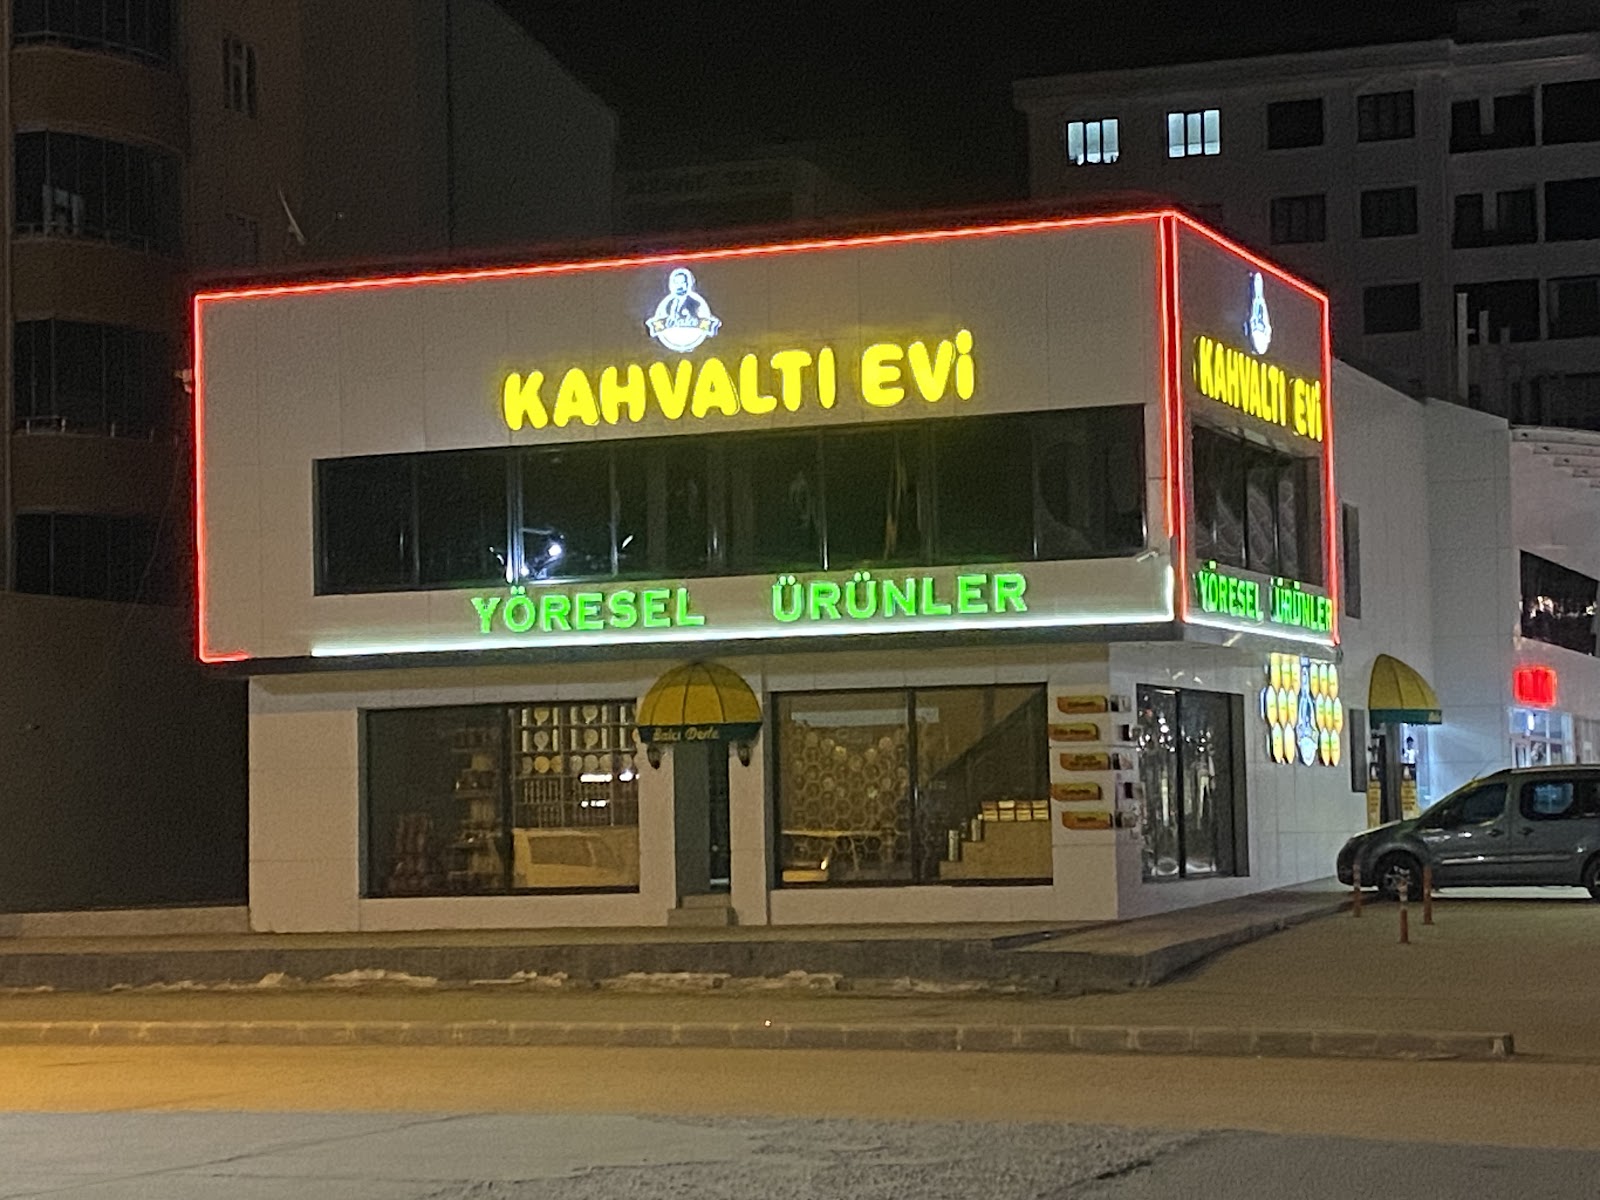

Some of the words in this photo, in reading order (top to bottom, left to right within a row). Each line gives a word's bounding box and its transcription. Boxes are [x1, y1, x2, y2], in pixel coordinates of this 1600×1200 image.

[503, 347, 838, 431] KAHVALTI
[1197, 336, 1287, 427] KAHVALTI
[470, 585, 706, 634] YÖRESEL
[772, 570, 1028, 623] ÜRÜNLER
[1196, 560, 1265, 621] YÖRESEL
[1270, 577, 1333, 632] ÜRÜNLER
